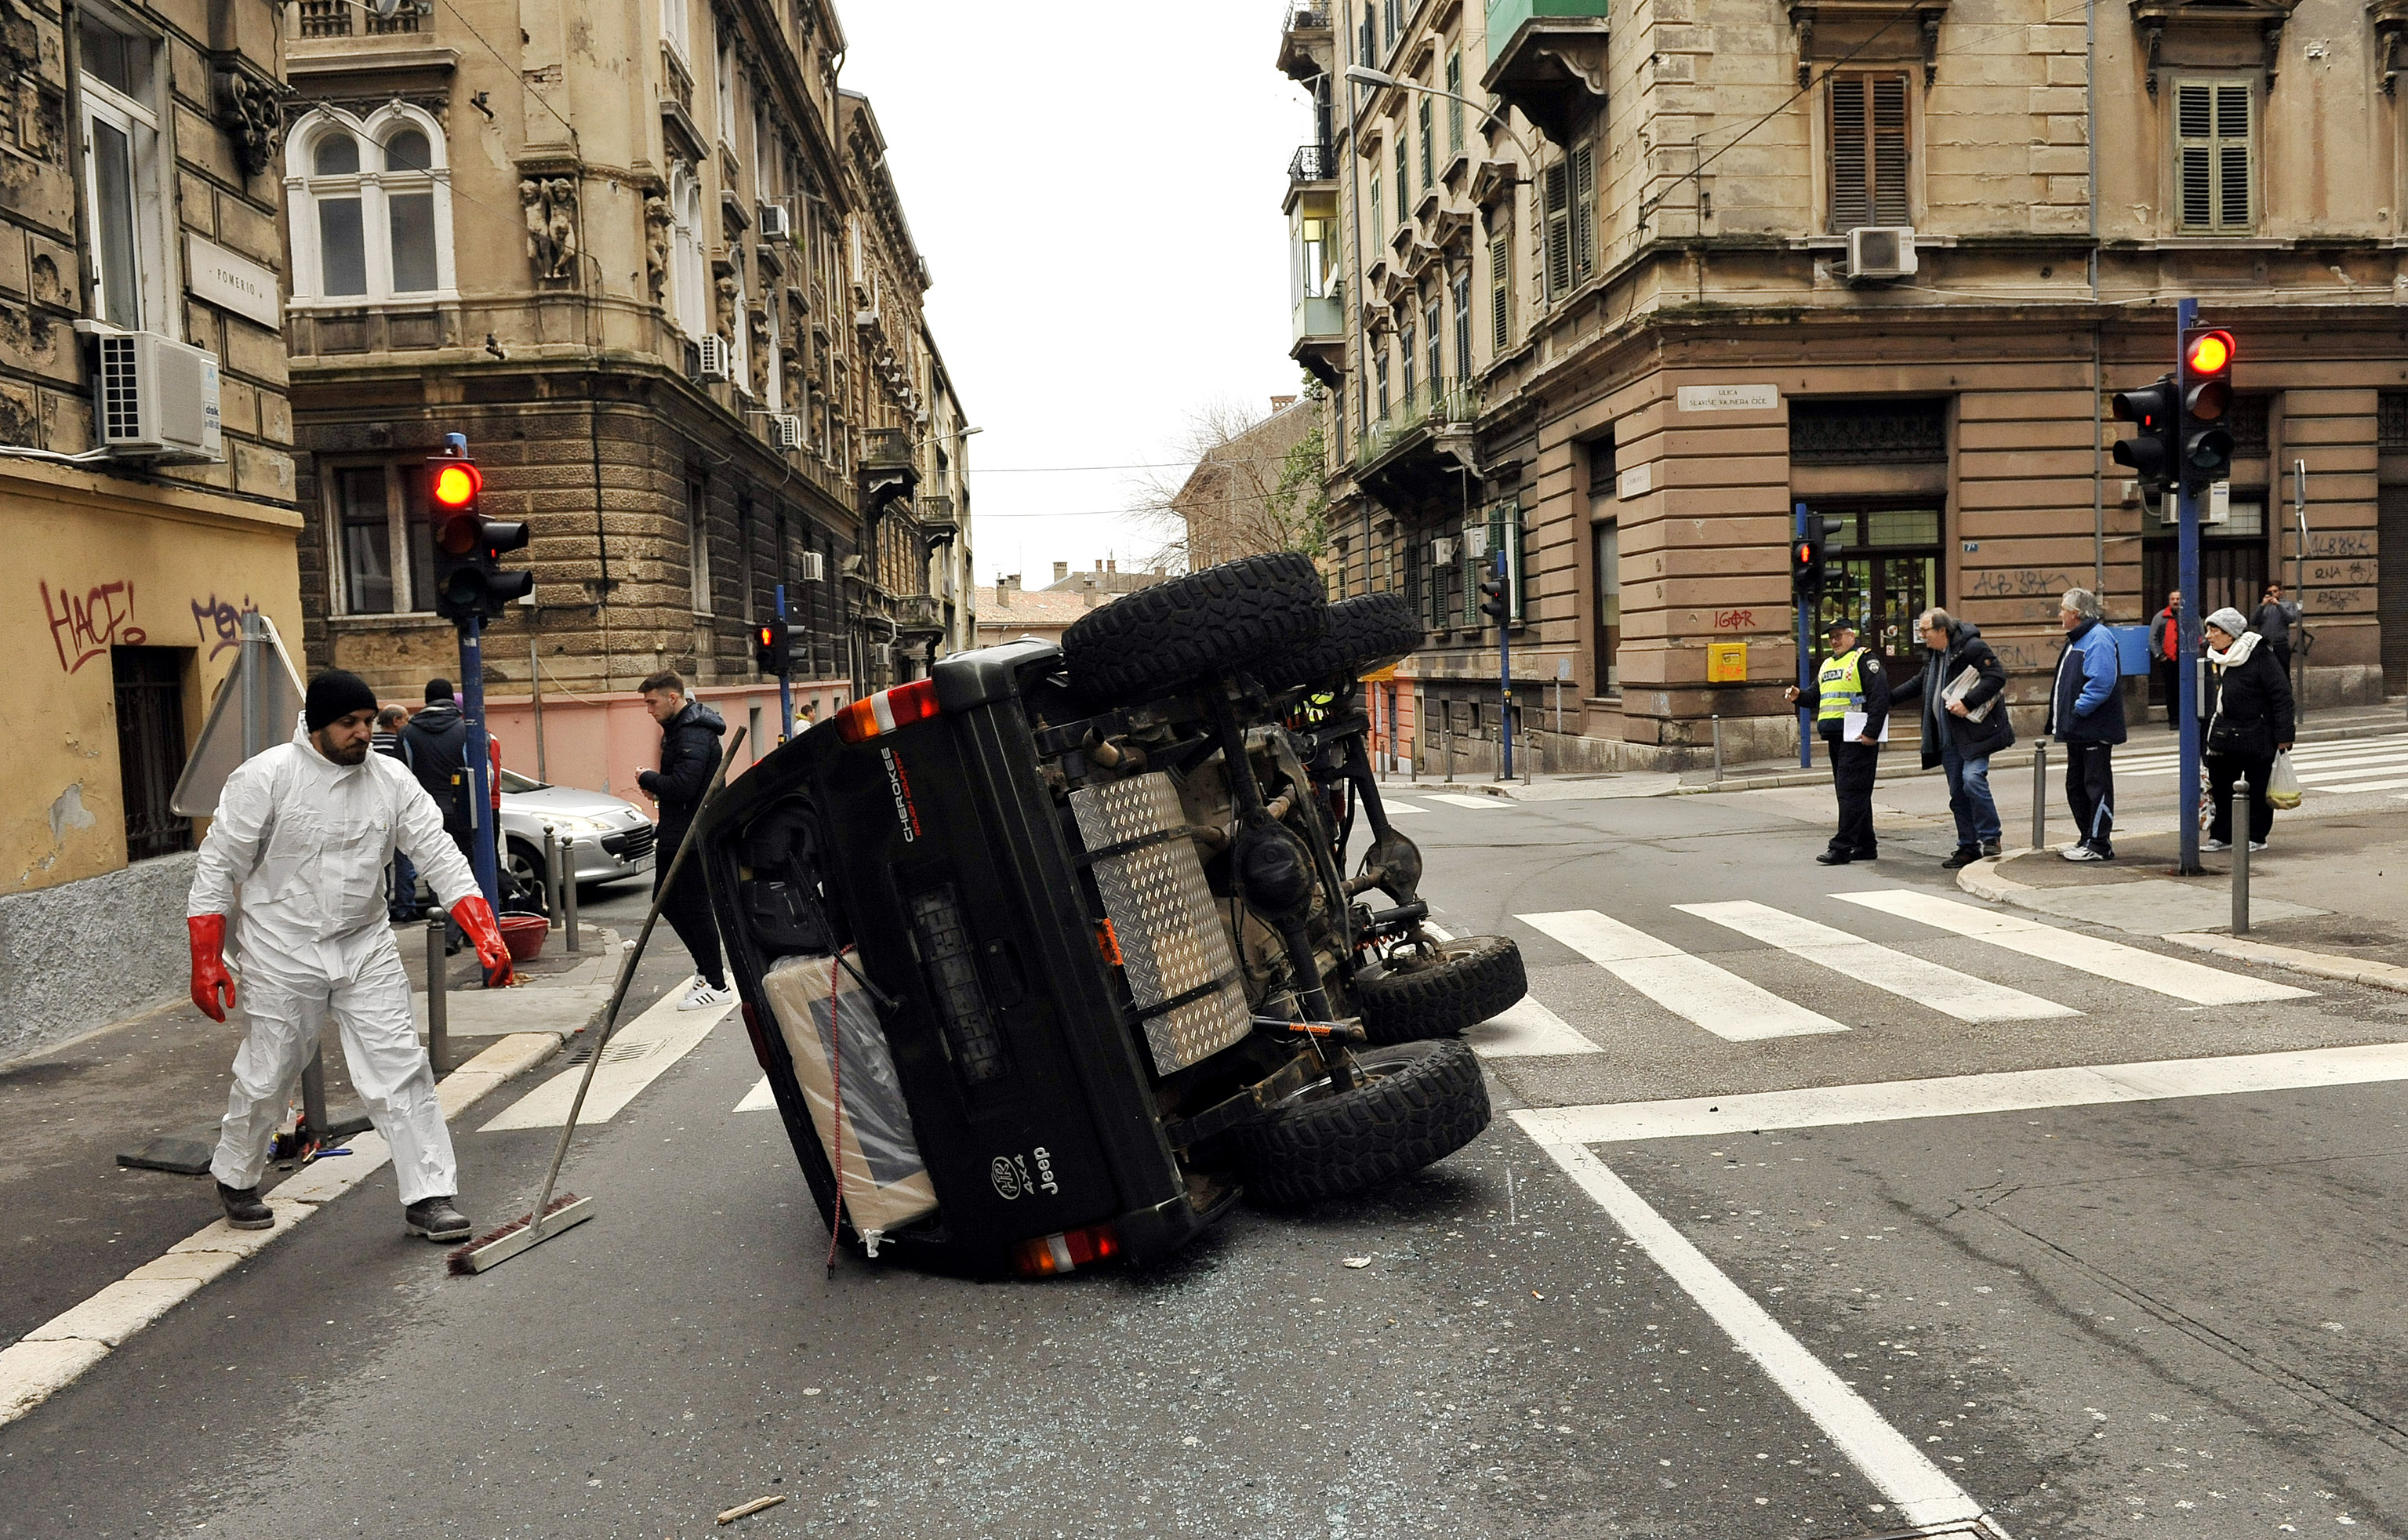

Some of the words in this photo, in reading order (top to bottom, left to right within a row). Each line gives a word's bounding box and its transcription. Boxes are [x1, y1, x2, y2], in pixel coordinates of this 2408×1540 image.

[217, 268, 255, 296] POMERIO
[205, 405, 220, 416] dsk
[1714, 609, 1756, 630] IGOR
[881, 747, 913, 842] CHEROKEE
[907, 801, 921, 836] ROUGH
[1033, 1147, 1058, 1195] Jeep
